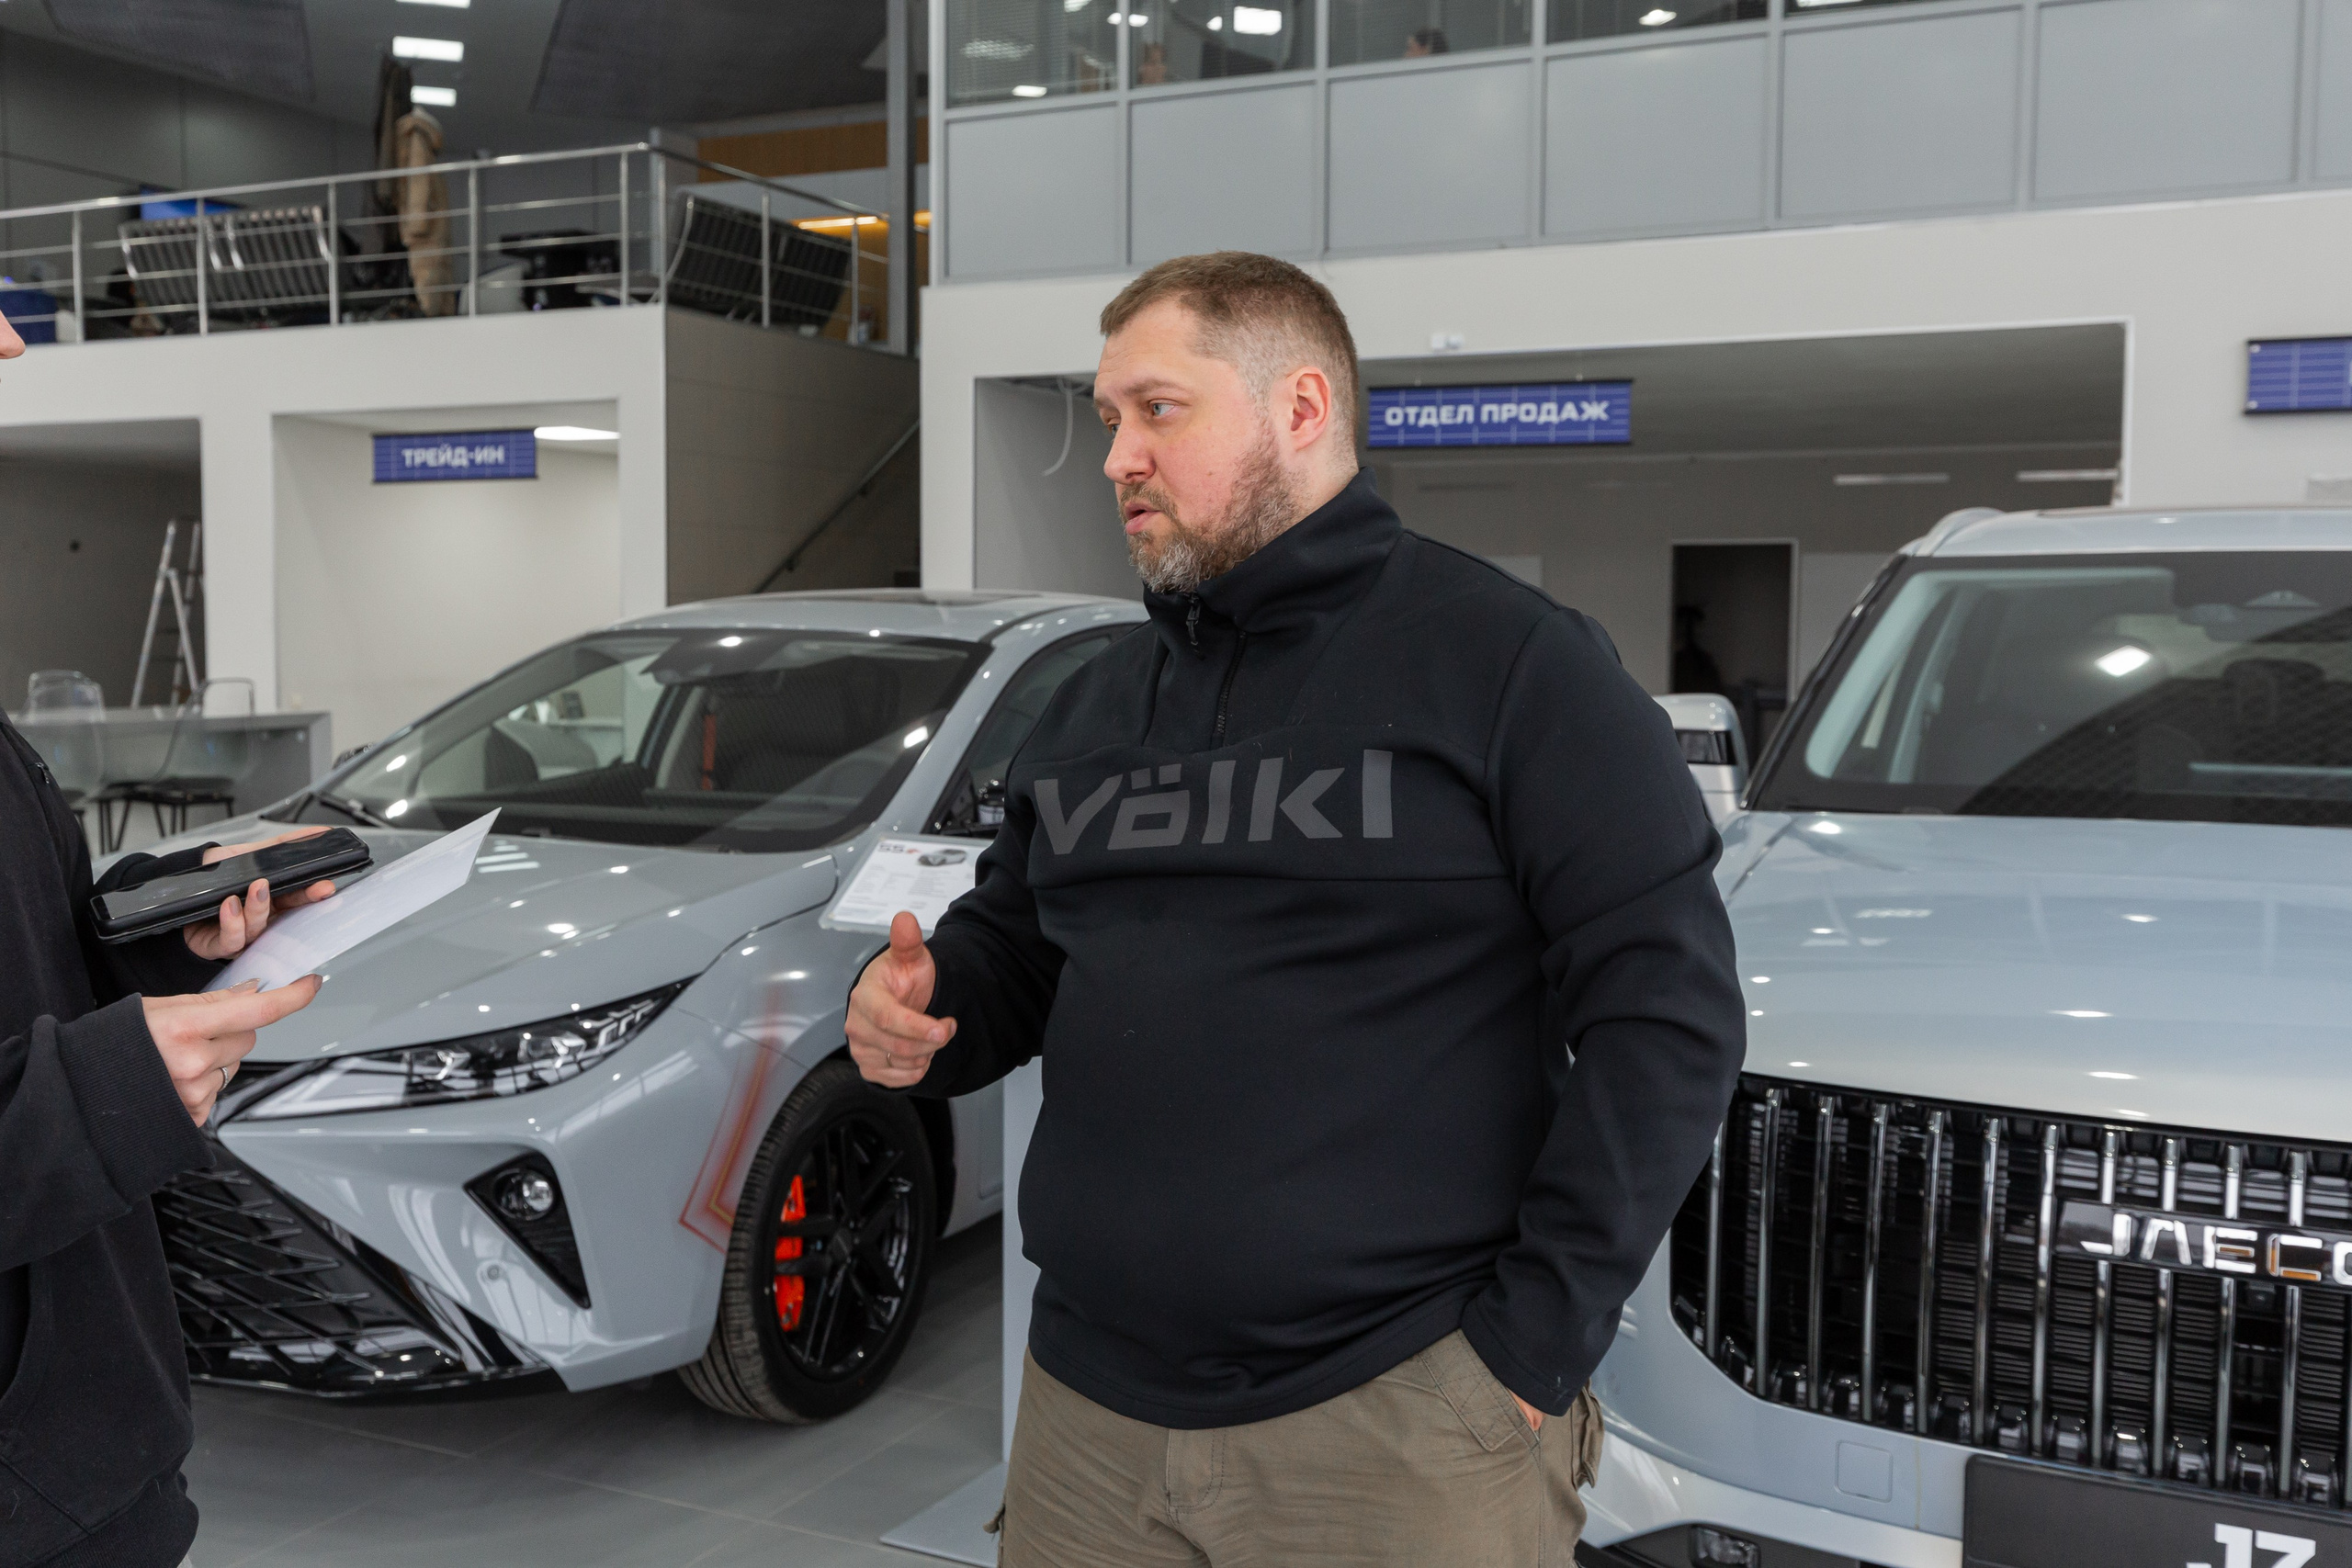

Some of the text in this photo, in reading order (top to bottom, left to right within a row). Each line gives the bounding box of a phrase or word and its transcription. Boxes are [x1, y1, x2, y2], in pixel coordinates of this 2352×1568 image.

[1385, 400, 1610, 427] ОТДЕЛ ПРОДАЖ
[401, 443, 505, 468] ТРЕЙД-ИН
